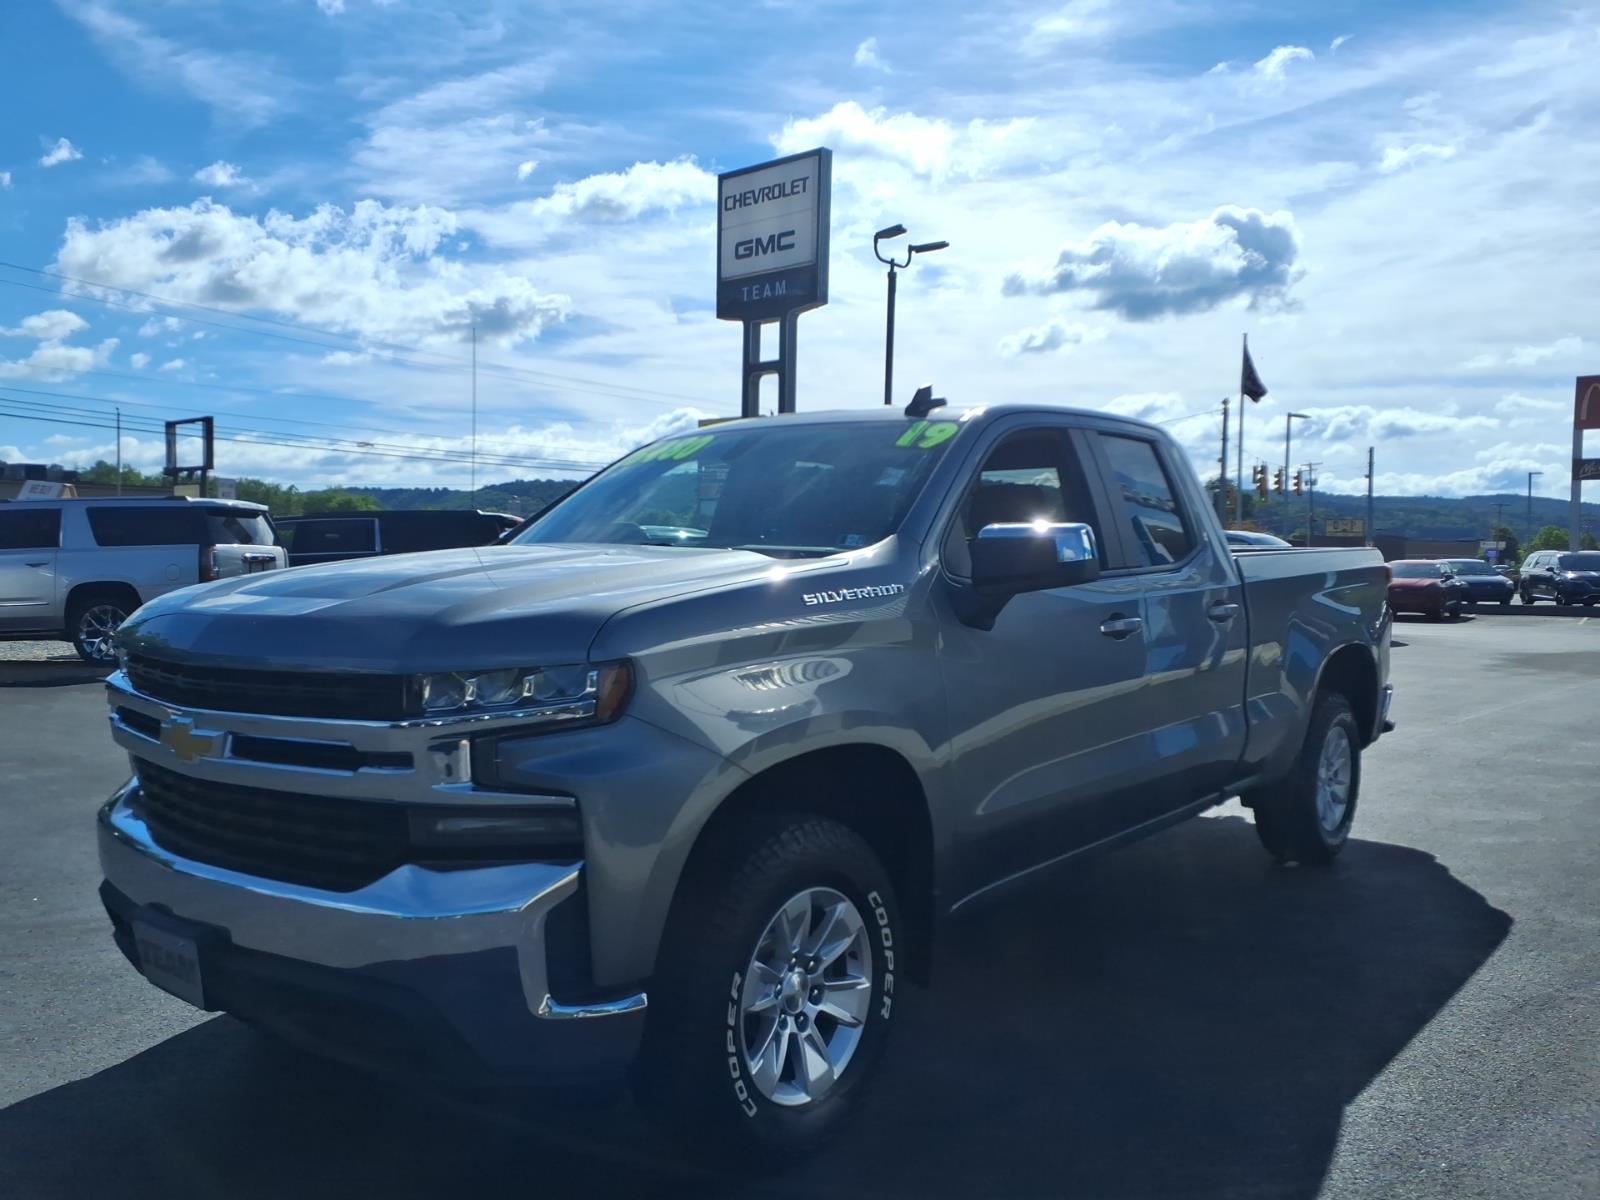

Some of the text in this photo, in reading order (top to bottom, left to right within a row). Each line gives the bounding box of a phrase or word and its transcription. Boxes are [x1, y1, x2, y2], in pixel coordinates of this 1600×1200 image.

[724, 176, 809, 211] CHEVROLET
[735, 230, 795, 260] GMC
[742, 280, 786, 302] TEAM
[895, 420, 959, 449] 19
[802, 583, 904, 606] SILVERADO
[867, 890, 895, 1020] COOPER
[725, 970, 758, 1119] COOPER
